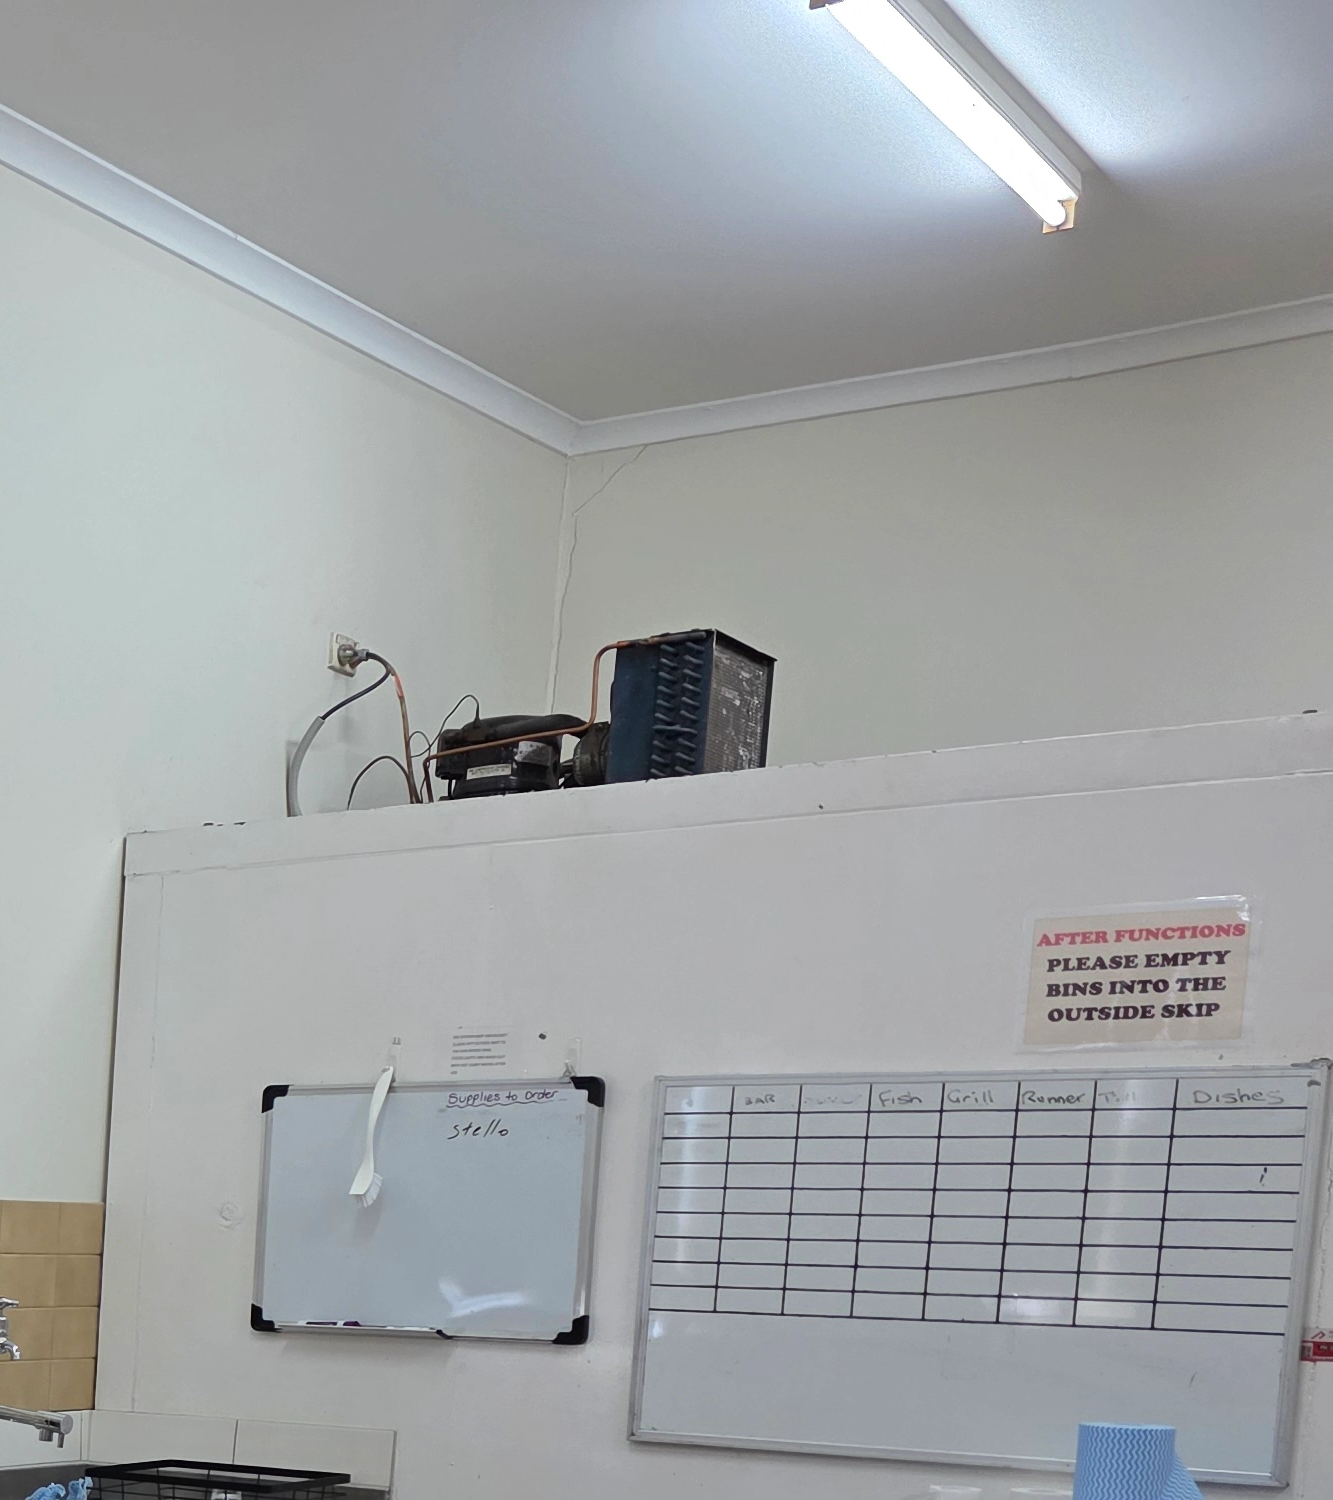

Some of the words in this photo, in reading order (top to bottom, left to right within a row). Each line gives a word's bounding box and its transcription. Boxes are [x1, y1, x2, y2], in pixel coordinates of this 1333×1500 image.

[1037, 931, 1109, 947] AFTER
[1114, 924, 1246, 943] FUNCTIONS
[1046, 954, 1139, 972] PLEASE
[1144, 950, 1231, 968] EMPTY
[1046, 981, 1103, 997] BINS
[1109, 979, 1170, 995] INTO
[1175, 976, 1227, 992] THE
[1047, 1005, 1155, 1022] OUTSIDE
[1161, 1002, 1220, 1019] SKIP
[448, 1091, 500, 1105] Supplies
[505, 1091, 518, 1100] to
